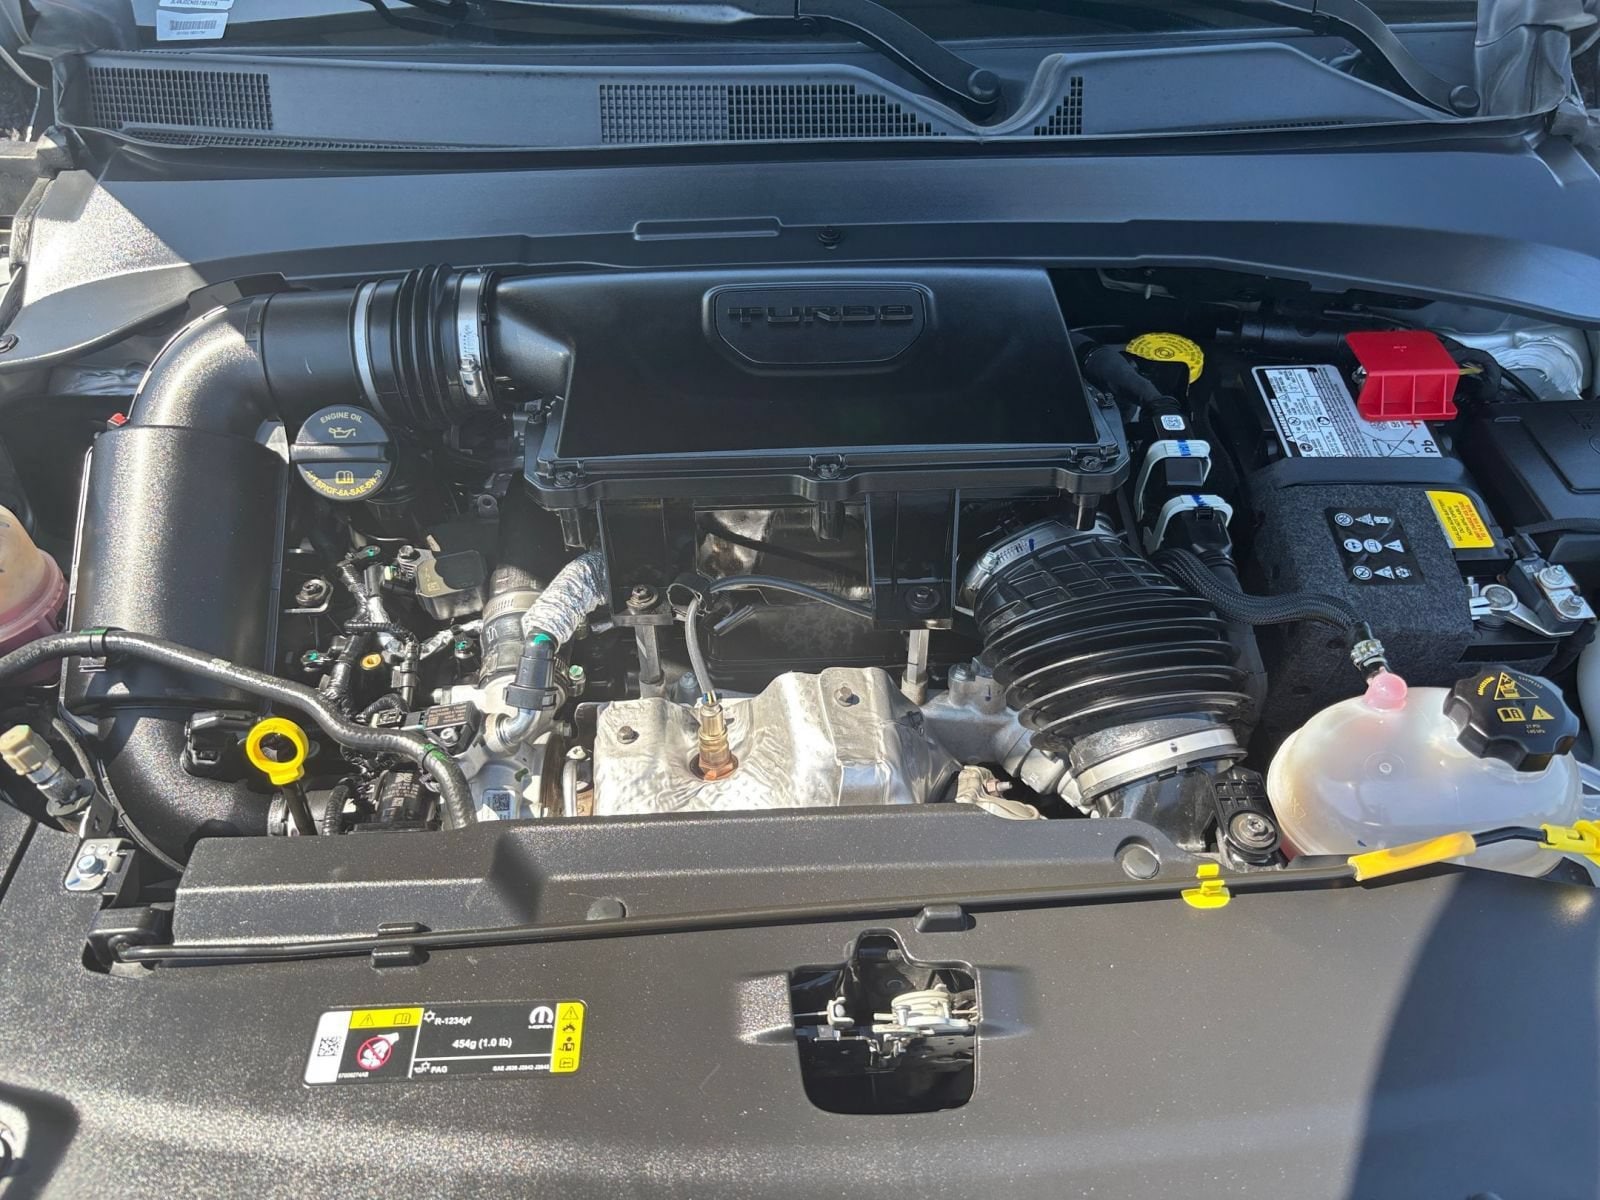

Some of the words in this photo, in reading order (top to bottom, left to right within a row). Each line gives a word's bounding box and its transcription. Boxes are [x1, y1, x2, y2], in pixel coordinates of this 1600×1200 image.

[728, 305, 913, 323] TURBO
[320, 412, 349, 424] ENGINE
[350, 413, 362, 424] OIL
[434, 1016, 472, 1026] R-1234yf
[452, 1039, 477, 1050] 454g
[478, 1038, 497, 1049] (1.0
[499, 1037, 512, 1048] lb)
[430, 1066, 448, 1074] PAG
